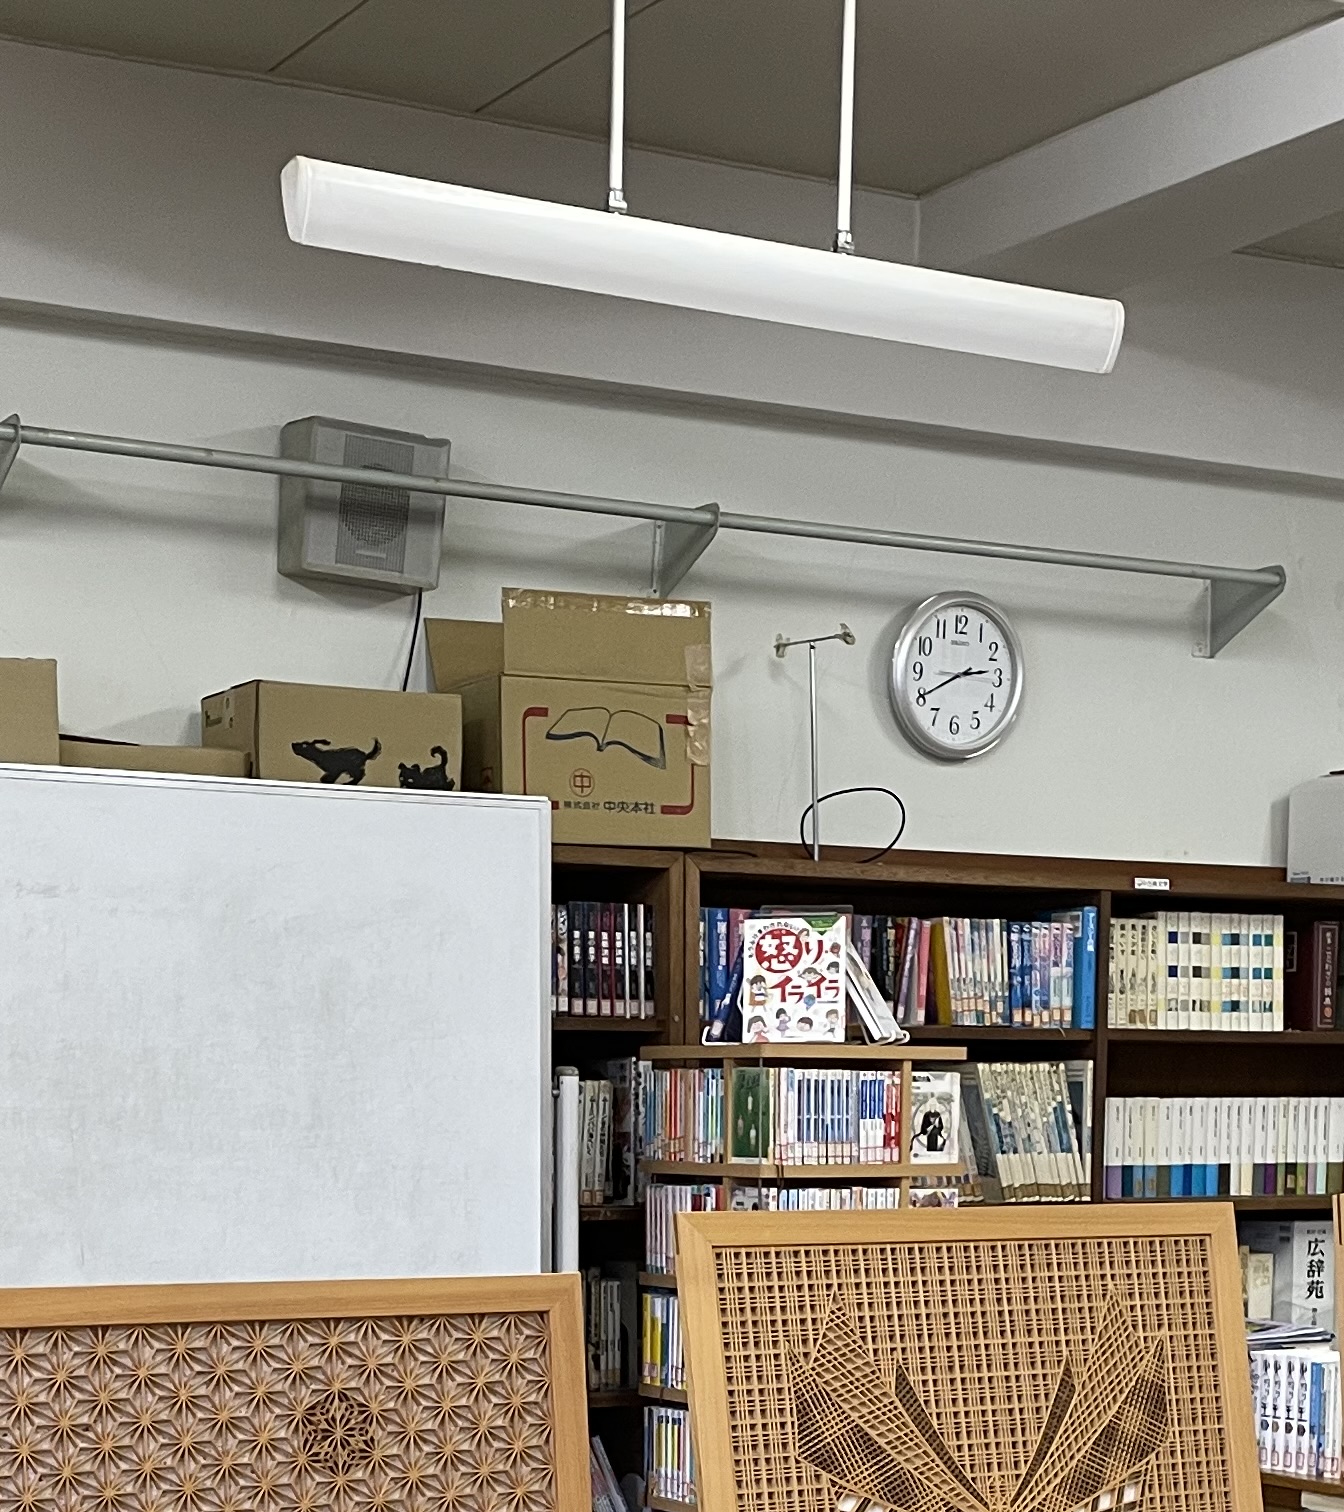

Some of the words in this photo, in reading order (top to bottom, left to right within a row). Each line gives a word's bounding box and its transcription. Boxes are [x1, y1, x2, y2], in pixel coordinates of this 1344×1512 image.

[936, 618, 947, 639] 11
[955, 614, 969, 635] 12
[979, 623, 984, 643] 1
[918, 636, 933, 656] 10
[988, 641, 999, 661] 2
[912, 661, 924, 681] 9
[991, 668, 1003, 688] 3
[915, 687, 927, 707] 8
[984, 693, 995, 712] 4
[930, 707, 941, 727] 7
[949, 715, 960, 735] 6
[969, 711, 981, 730] 5
[573, 771, 592, 794] 中
[603, 800, 656, 815] 中央本社
[769, 975, 840, 1005] イライラ
[1305, 1237, 1326, 1300] 広辞苑
